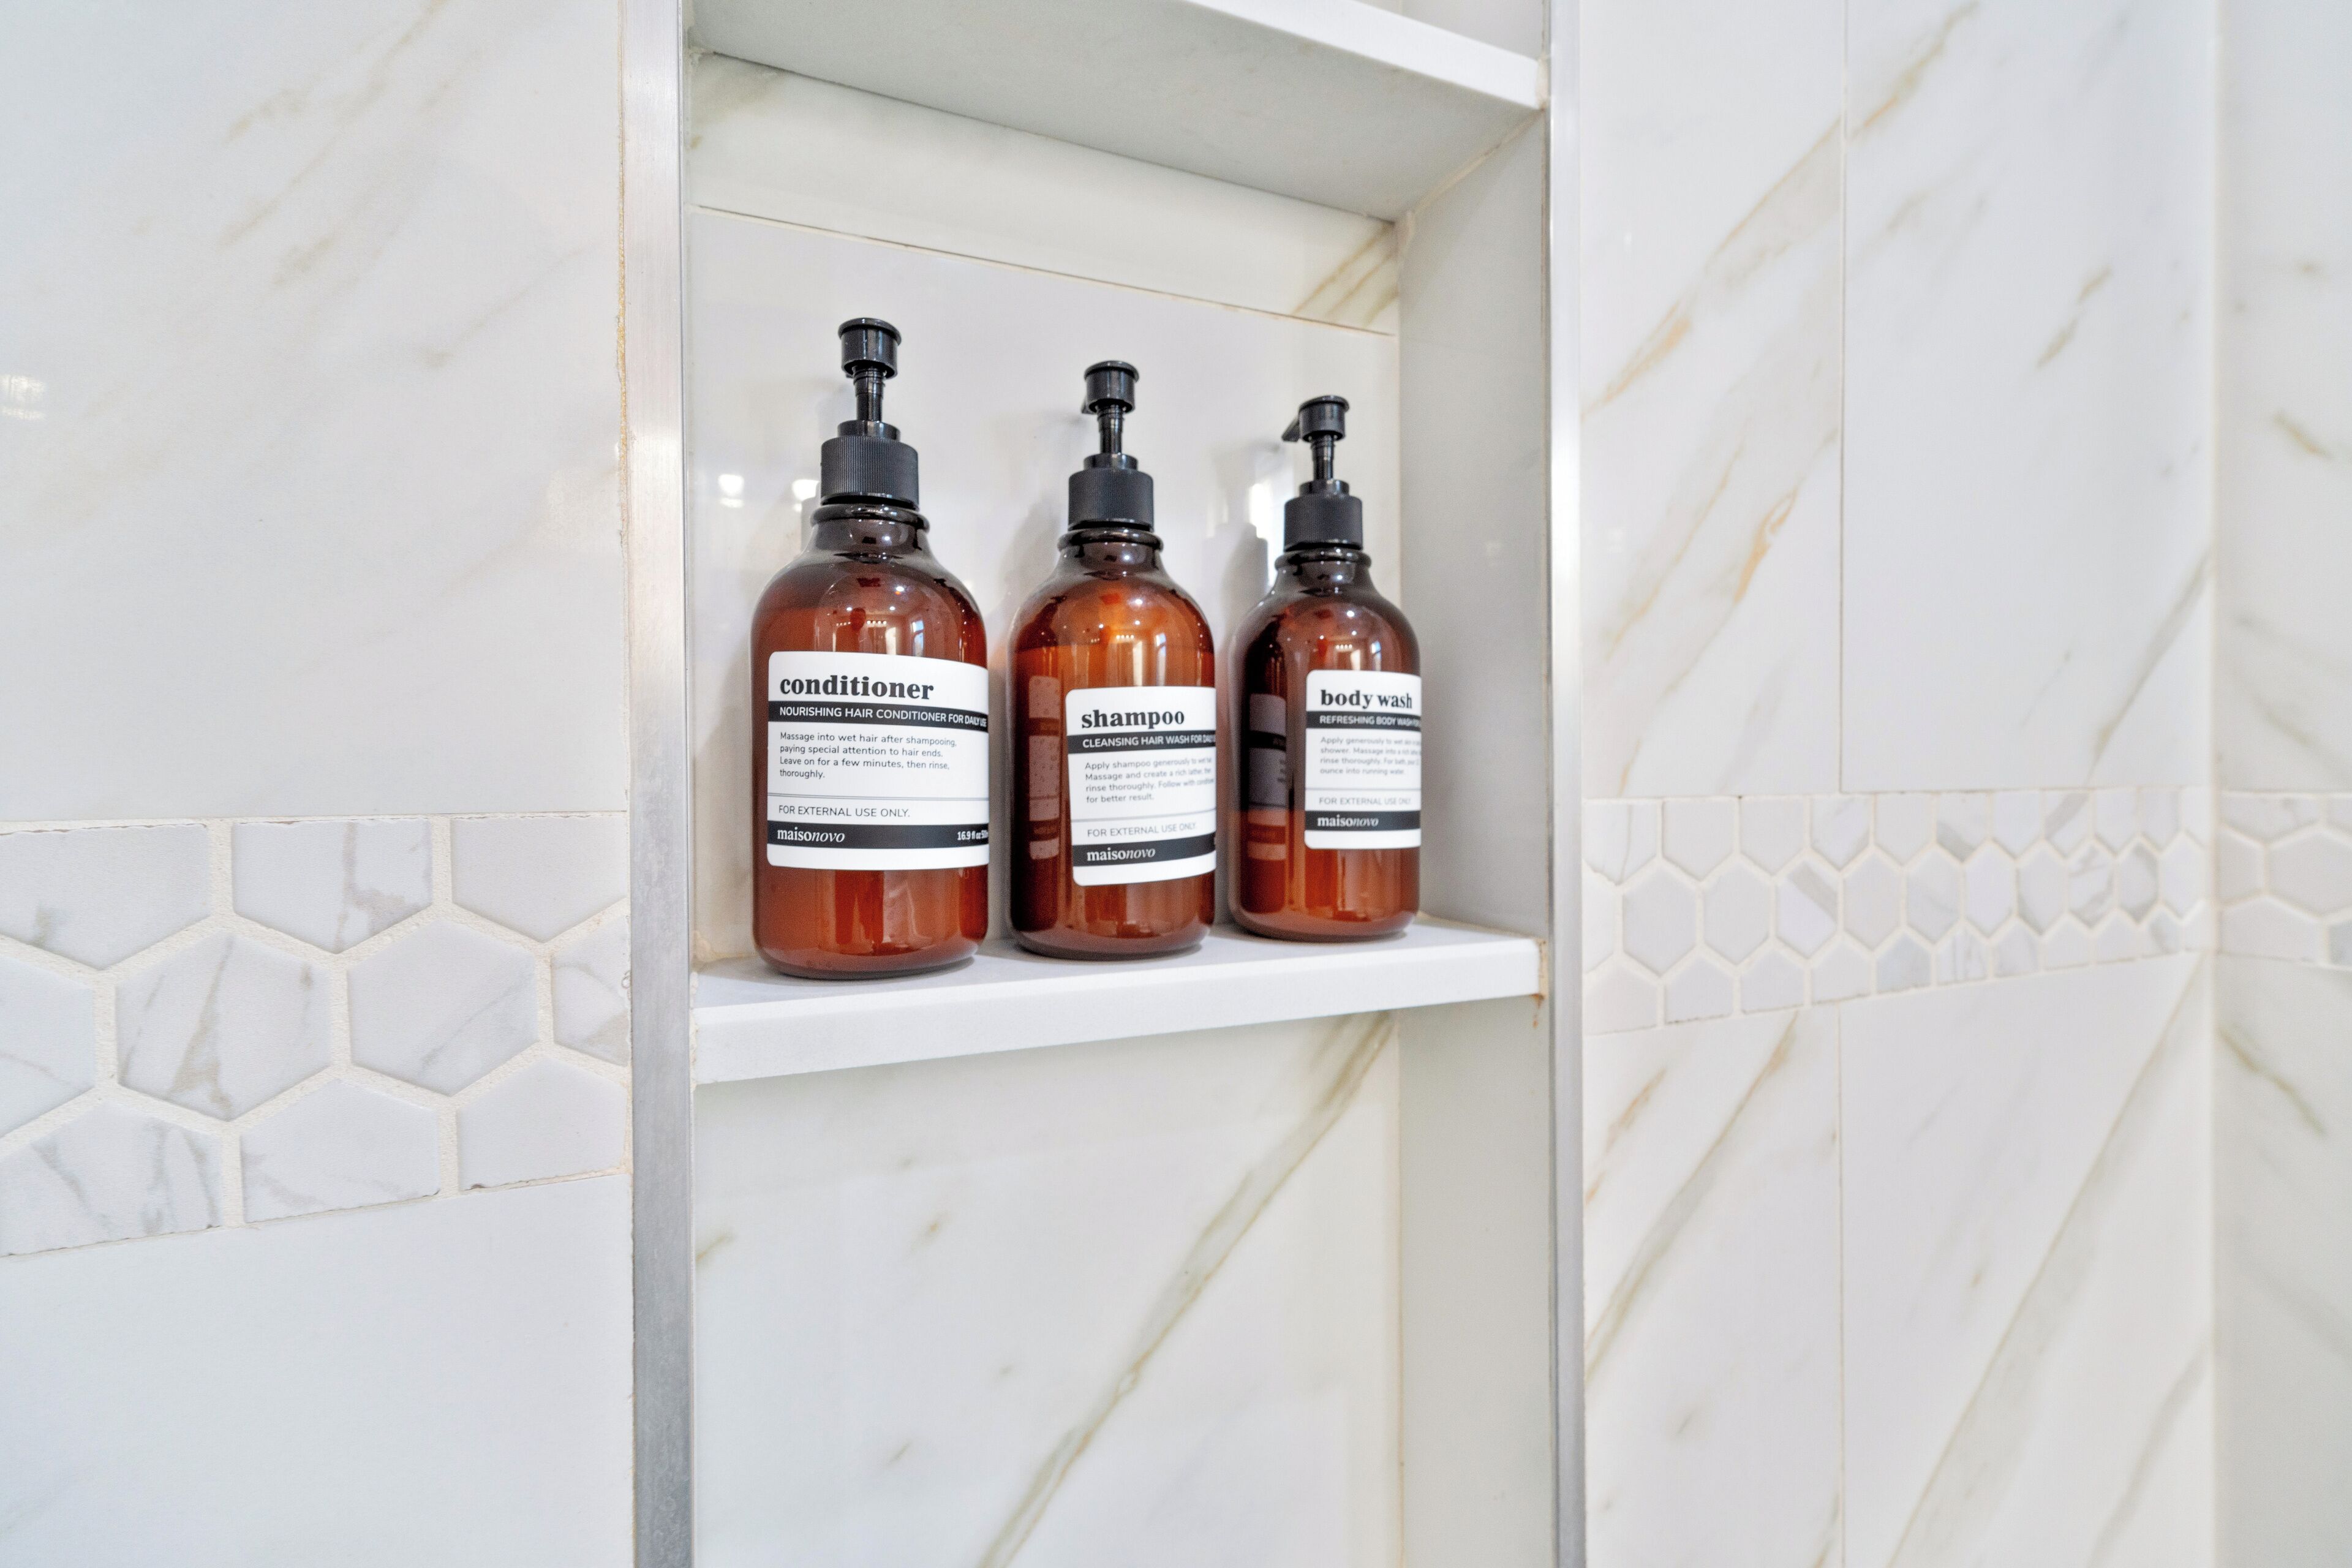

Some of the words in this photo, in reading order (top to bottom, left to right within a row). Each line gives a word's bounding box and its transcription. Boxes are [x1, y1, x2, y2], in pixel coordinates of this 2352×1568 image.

[780, 675, 934, 699] conditioner
[1321, 690, 1373, 709] body
[1376, 693, 1412, 708] wash
[779, 707, 842, 717] NOURISHING
[845, 709, 873, 718] HAIR
[876, 710, 946, 722] CONDITIONER
[948, 714, 963, 723] FOR
[965, 715, 979, 725] DAILY
[1082, 710, 1185, 729] shampoo
[1319, 715, 1374, 725] REFRESHING
[1376, 715, 1396, 725] BODY
[780, 733, 815, 742] Massage
[881, 735, 902, 744] after
[1083, 737, 1139, 748] CLEANSING
[1141, 737, 1164, 745] HAIR
[1321, 737, 1343, 745] Apply
[1346, 737, 1384, 745] generously
[780, 746, 805, 755] paying
[809, 746, 839, 755] special
[843, 747, 886, 755] attention
[842, 758, 859, 767] few
[1112, 760, 1151, 769] shampoo
[1153, 758, 1189, 768] generously
[780, 769, 825, 778] thoroughly.
[1086, 772, 1123, 781] Massage
[1109, 781, 1156, 791] thoroughly.
[779, 805, 795, 814] FOR
[798, 807, 851, 816] EXTERNAL
[881, 809, 910, 818] ONLY.
[1317, 815, 1378, 827] maisonovo
[777, 827, 845, 843] maisonovo
[957, 832, 971, 840] 16.9
[1110, 826, 1159, 836] EXTERNAL
[1087, 848, 1155, 862] maisonovo
